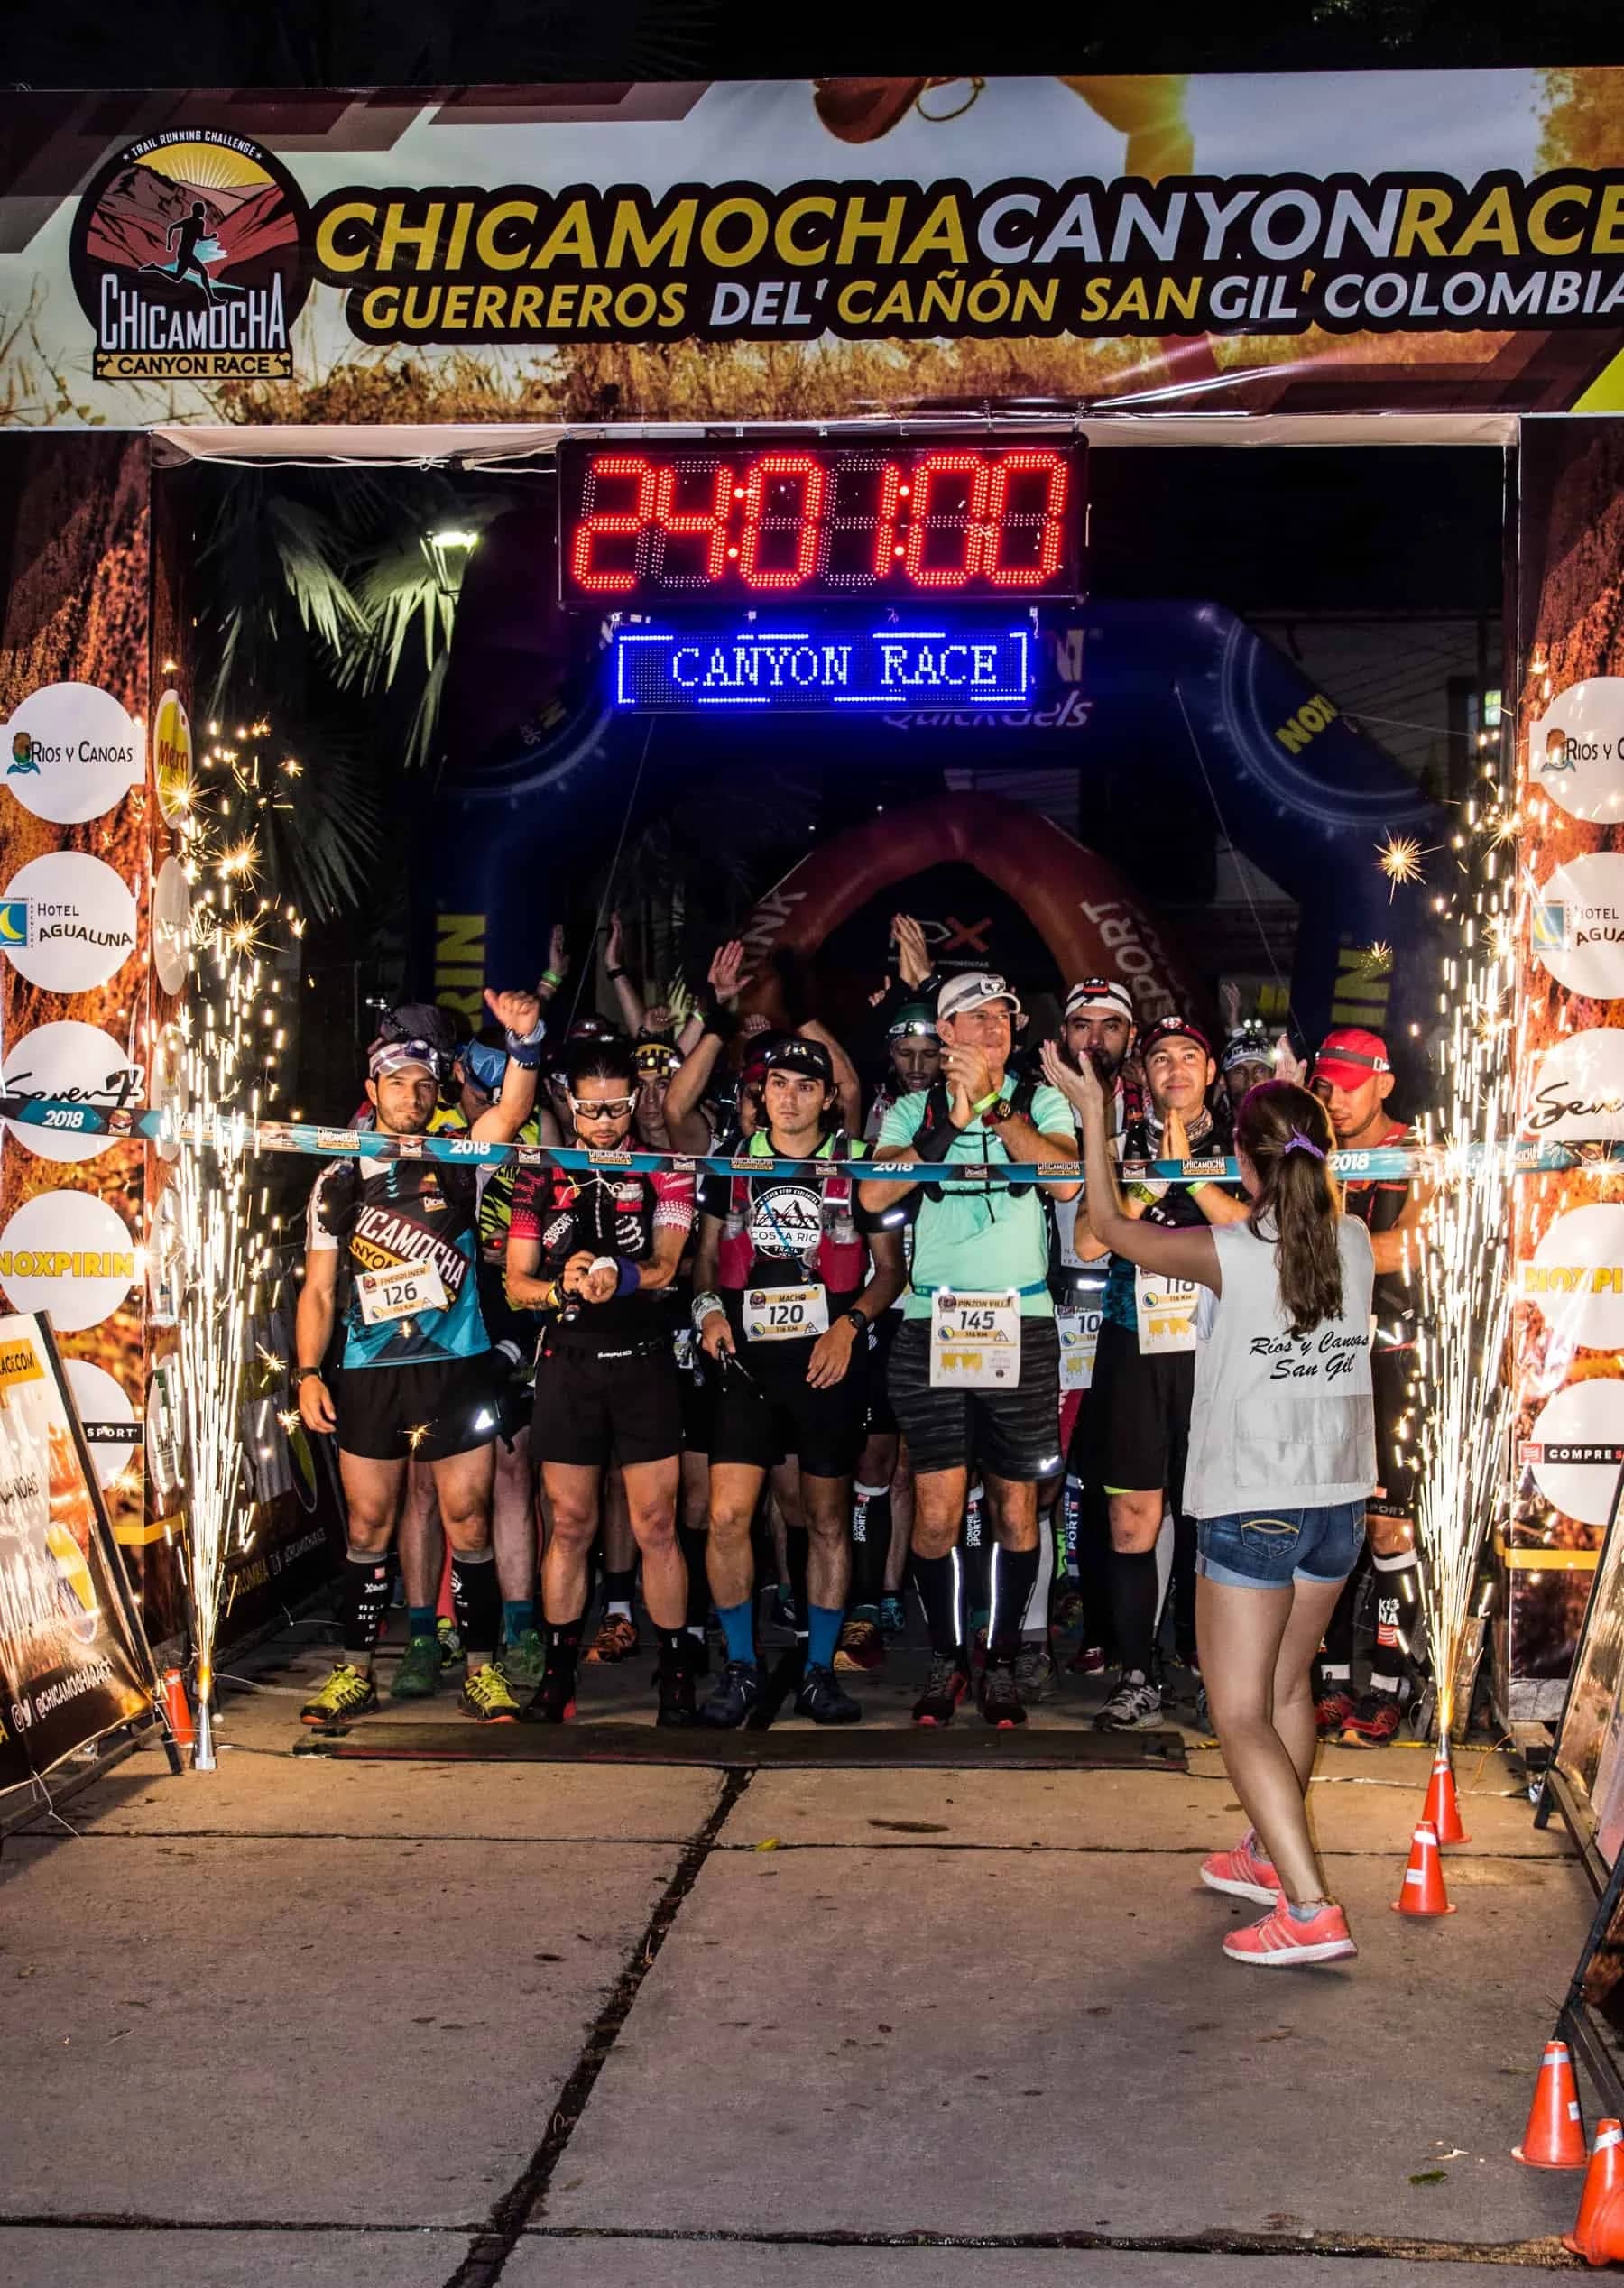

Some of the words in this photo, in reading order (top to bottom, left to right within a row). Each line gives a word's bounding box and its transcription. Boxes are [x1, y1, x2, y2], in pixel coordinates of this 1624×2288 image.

[131, 138, 158, 157] TRAIL
[160, 130, 201, 144] RUNNING
[204, 130, 256, 157] CHALLENGE
[100, 272, 287, 351] CHICAMOCHA
[363, 281, 688, 330] GUERREROS
[837, 270, 1060, 324] CAÑÓN
[117, 355, 208, 374] CANYON
[213, 355, 270, 374] RACE
[573, 454, 1069, 589] 24:01:00
[672, 645, 853, 687] CANYON
[880, 645, 998, 687] RACE
[32, 740, 61, 764] RIOS
[67, 747, 75, 764] Y
[78, 740, 134, 763] CANOAS
[1566, 737, 1598, 760] RIOS
[1603, 743, 1612, 760] Y
[37, 903, 80, 917] HOTEL
[39, 923, 134, 947] AGUALUNA
[42, 1110, 84, 1128] 2018
[450, 1139, 491, 1156] 2018
[872, 1162, 915, 1172] 2018
[1331, 1153, 1370, 1171] 2018
[751, 1229, 793, 1242] COSA
[0, 1250, 134, 1278] NOXPIRIN
[383, 1281, 418, 1306] 126
[957, 1298, 987, 1307] PINZON
[770, 1305, 804, 1325] 120
[960, 1310, 996, 1330] 145
[1270, 1358, 1318, 1380] San
[1325, 1352, 1355, 1381] Gil
[87, 1427, 134, 1437] SPORT
